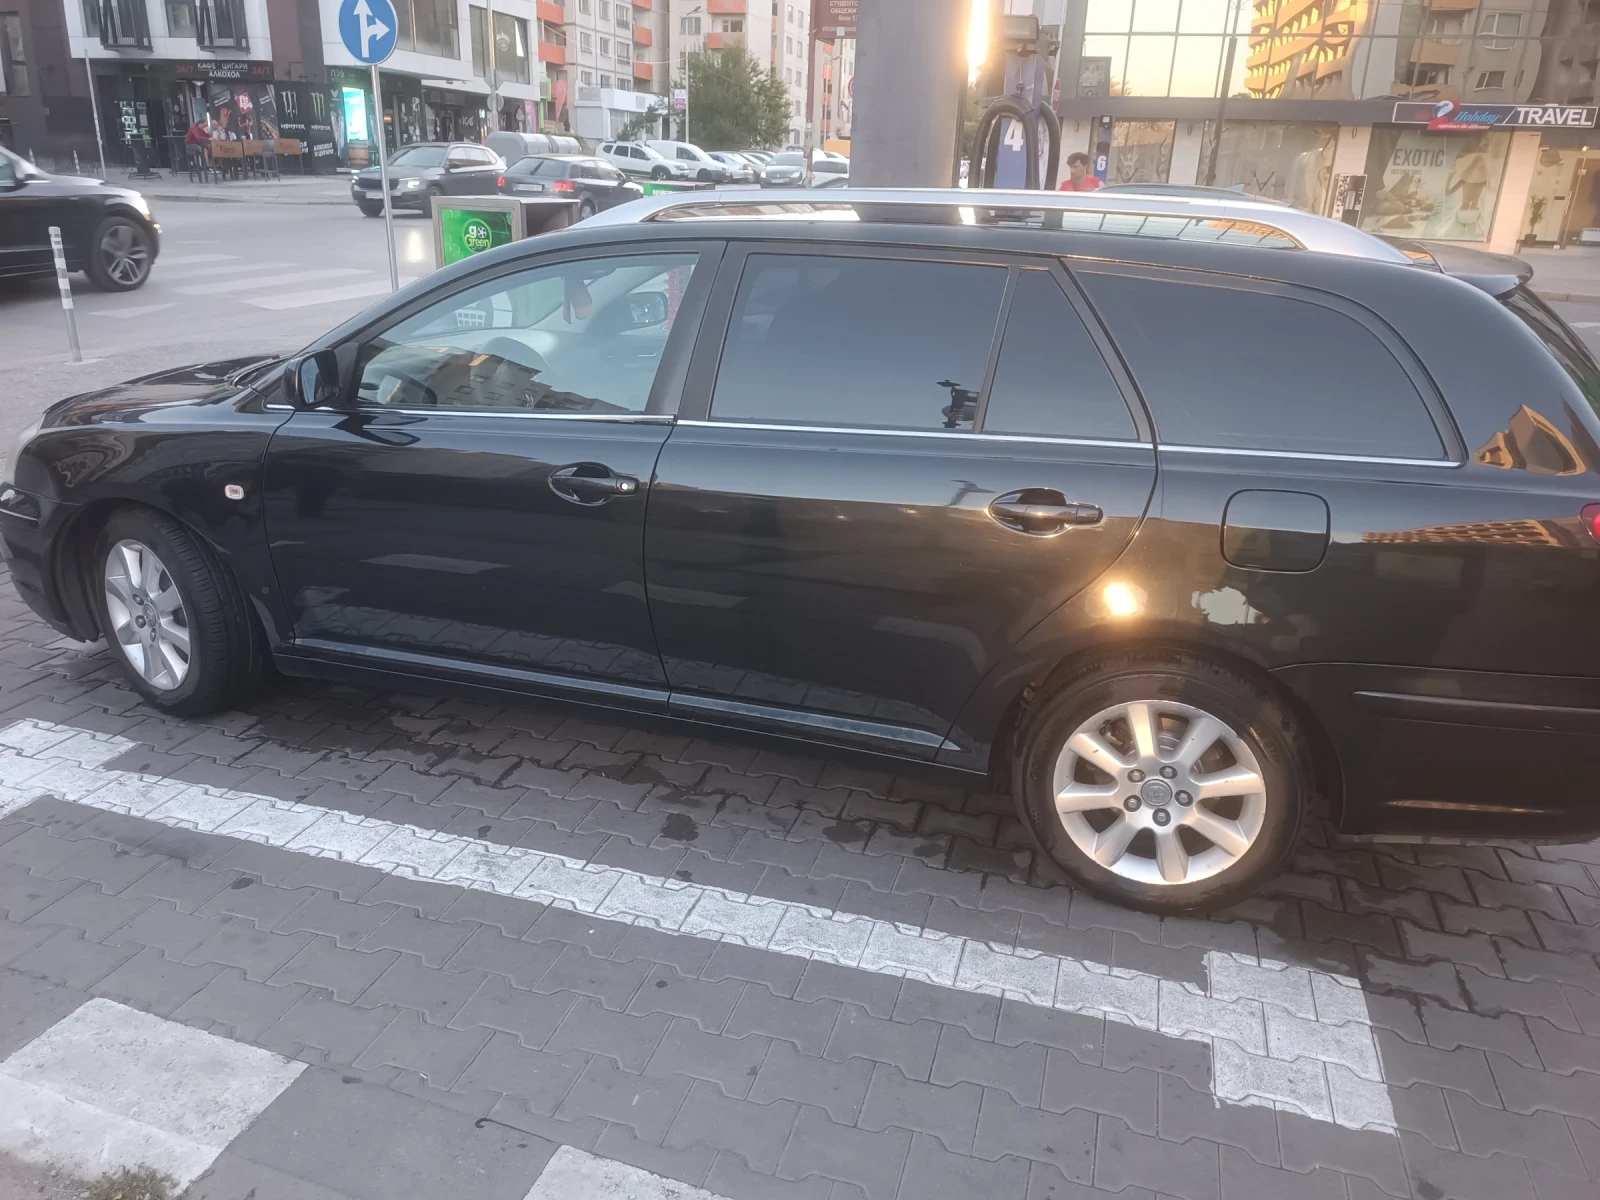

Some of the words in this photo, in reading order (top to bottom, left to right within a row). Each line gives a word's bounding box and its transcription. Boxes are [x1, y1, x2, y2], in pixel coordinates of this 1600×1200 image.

[176, 65, 194, 73] 24/7
[221, 62, 248, 70] ЦИГАРИ
[252, 67, 270, 75] 24/7
[1454, 111, 1500, 124] Holiday
[1516, 107, 1592, 126] TRAVEL
[1003, 119, 1024, 151] 4
[1096, 155, 1106, 171] 6
[1392, 148, 1445, 167] EXOTIC
[464, 234, 491, 250] Green
